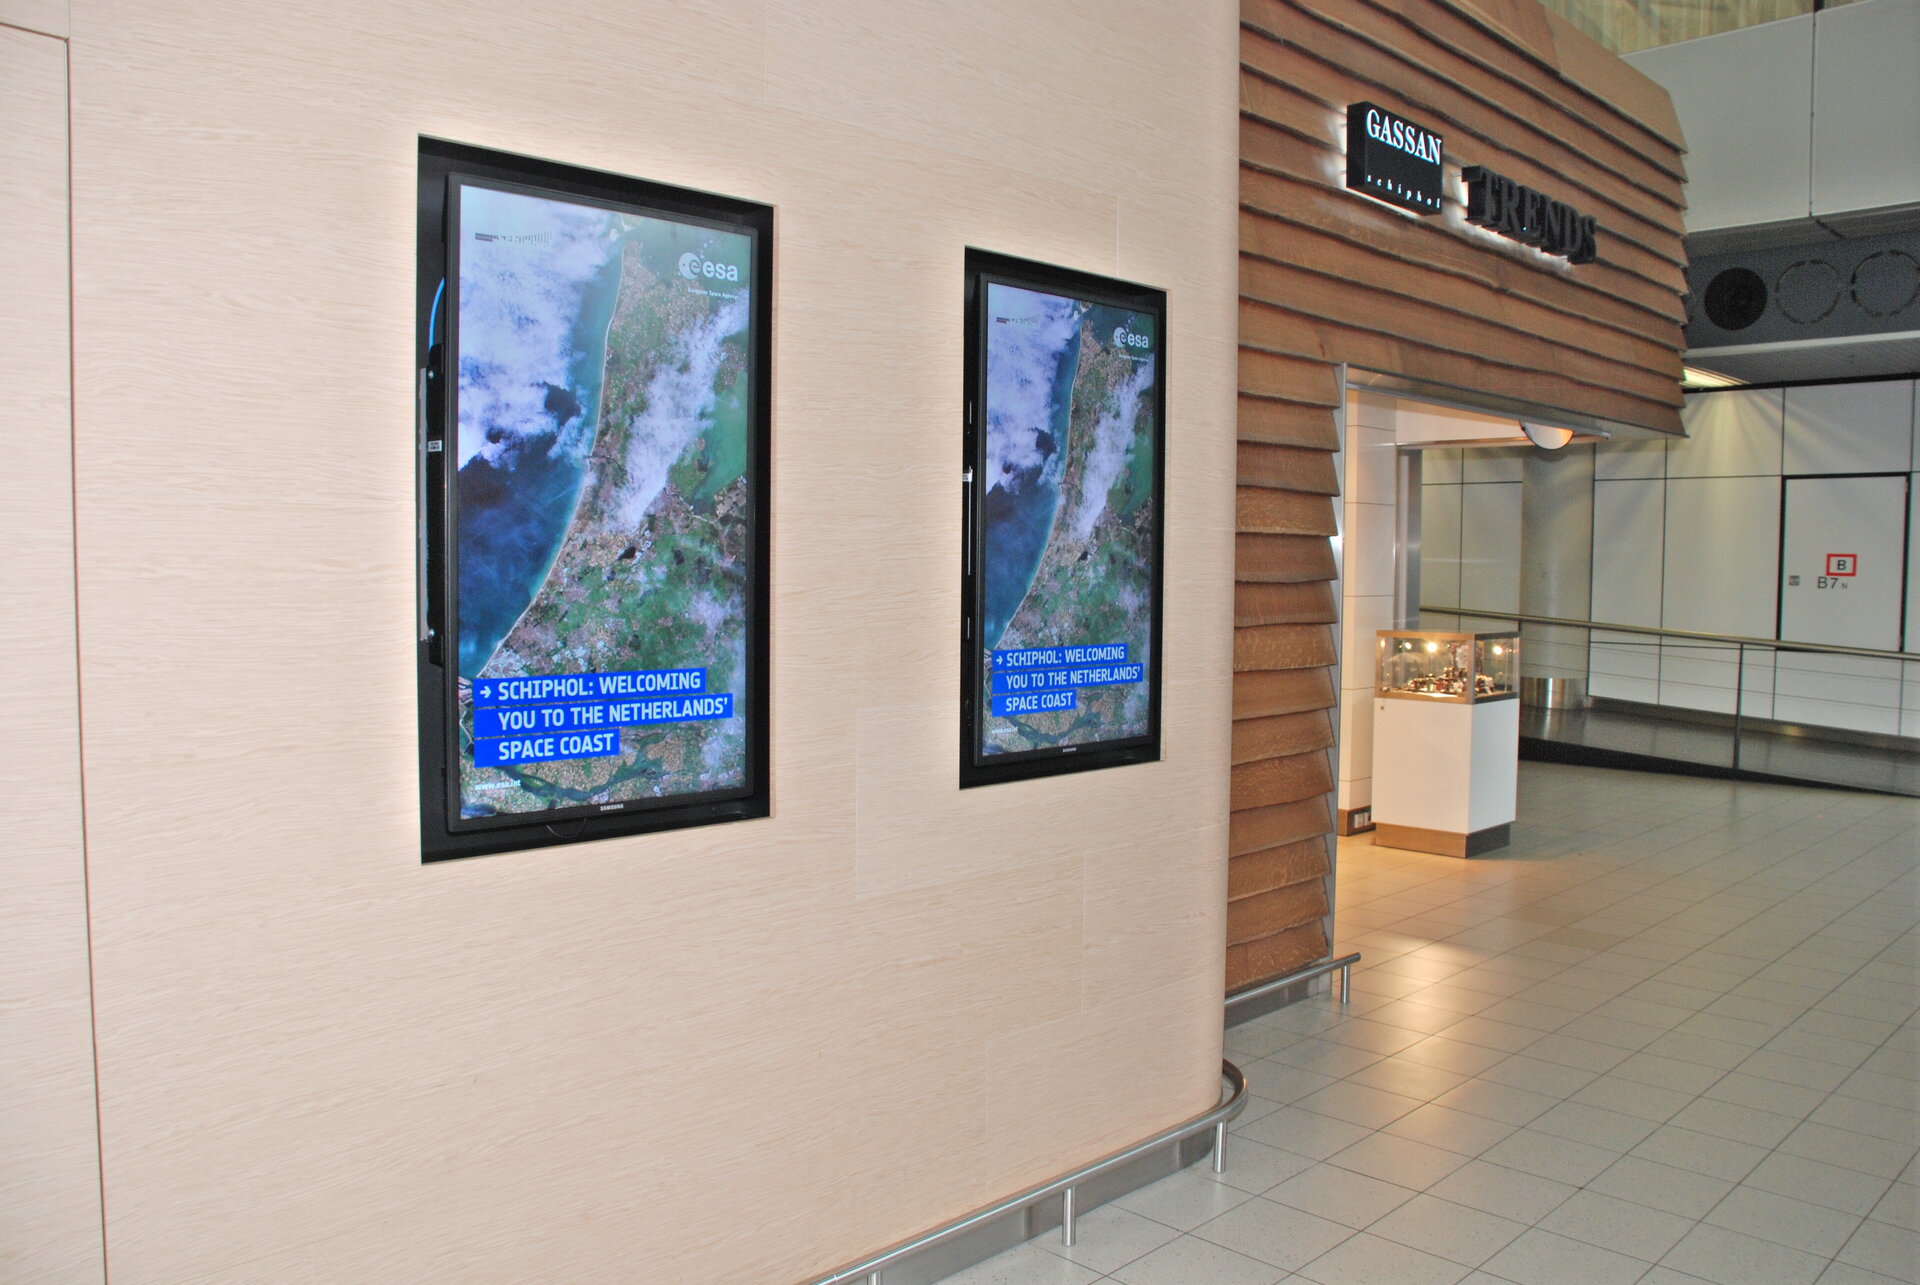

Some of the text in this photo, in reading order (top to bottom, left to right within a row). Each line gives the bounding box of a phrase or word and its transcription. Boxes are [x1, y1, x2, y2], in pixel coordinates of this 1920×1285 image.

[1366, 108, 1442, 165] GASSAN
[1367, 173, 1440, 209] schiphol
[1462, 165, 1597, 265] TRENDS
[702, 260, 739, 282] esa
[1836, 559, 1847, 571] B
[1817, 576, 1839, 589] B7
[1006, 646, 1125, 667] SCHIPHOL: WELCOMING
[498, 671, 701, 701] SCHIPHOL: WELCOMING
[1006, 674, 1028, 689] YOU
[1031, 672, 1045, 687] TO
[1047, 670, 1067, 685] THE
[1006, 692, 1073, 712] SPACE COAST
[498, 710, 536, 731] YOU
[541, 709, 565, 727] TO
[570, 706, 604, 725] THE
[498, 733, 614, 760] SPACE COAST
